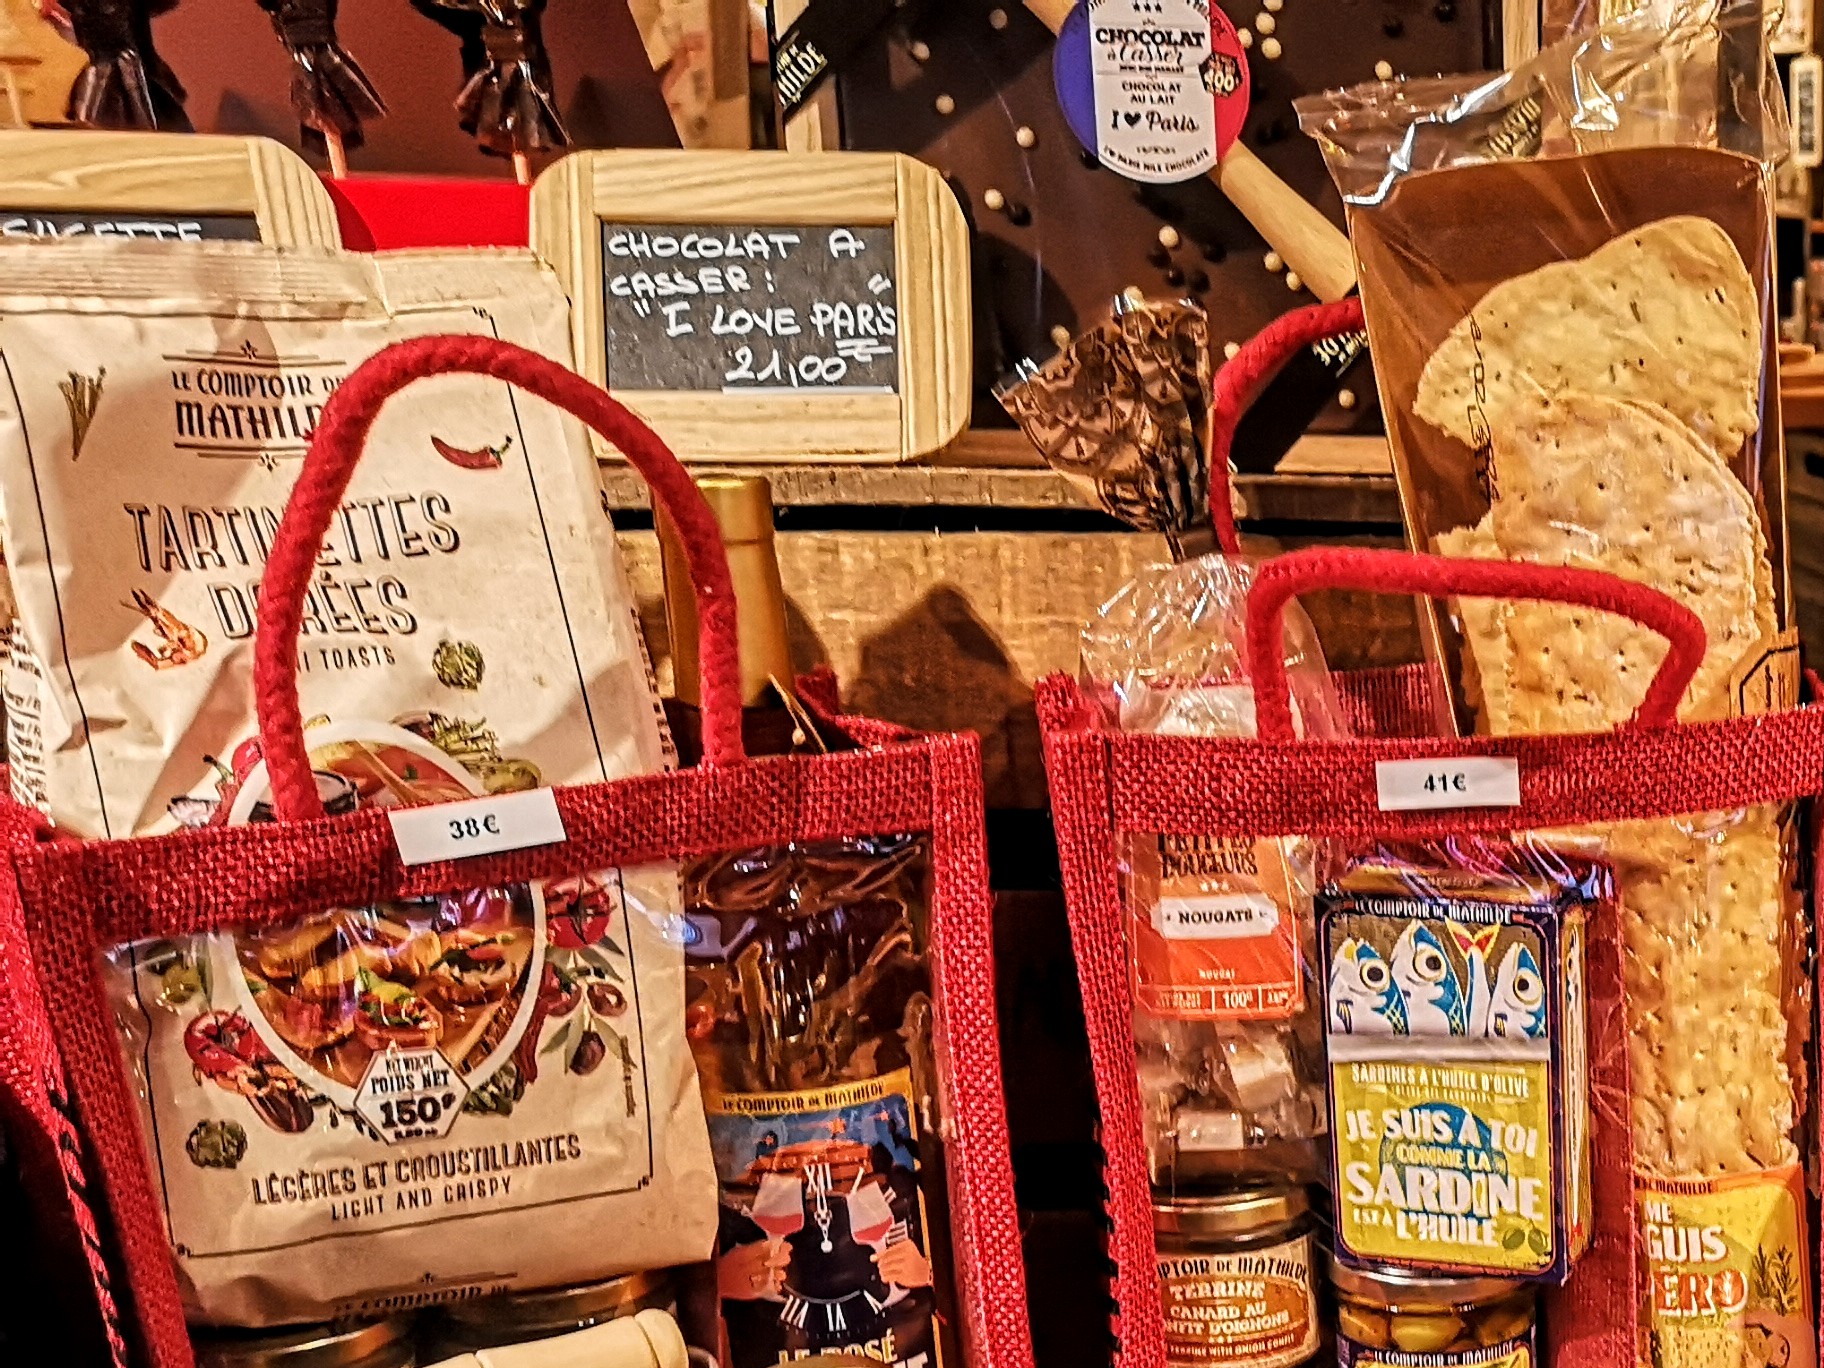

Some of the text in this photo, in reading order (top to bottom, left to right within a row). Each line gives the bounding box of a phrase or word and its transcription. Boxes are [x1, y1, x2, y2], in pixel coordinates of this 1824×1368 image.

[1096, 28, 1205, 48] CHOCOLAT
[1122, 82, 1182, 92] CHOCOLAT
[1131, 95, 1174, 105] AU LAIT
[1146, 110, 1199, 132] Paris
[609, 232, 800, 260] CHOCOLAT
[711, 308, 800, 337] LOVE
[197, 368, 313, 399] COMPTOIR
[175, 400, 325, 443] MATHIL
[319, 647, 396, 672] TOASTS
[1423, 774, 1467, 792] 41€
[449, 814, 501, 840] 38€
[371, 1074, 415, 1094] POIDS
[1351, 1064, 1417, 1084] SARDINES
[1432, 1068, 1479, 1091] L'HUILE
[1480, 1073, 1529, 1098] D'OLIVE
[736, 1082, 886, 1113] COMPTOIR MATHILDE
[1345, 1102, 1537, 1158] JE SUIS À TOI
[362, 1134, 582, 1190] ET CROUSTILLANTES
[1396, 1146, 1490, 1171] COMME LA
[331, 1177, 513, 1221] LIGHT AND CRISPY
[1345, 1161, 1544, 1222] SARDINE
[1396, 1213, 1500, 1247] L'HUILE
[1170, 1280, 1266, 1300] TERRINE
[1171, 1301, 1267, 1322] CANARD AU
